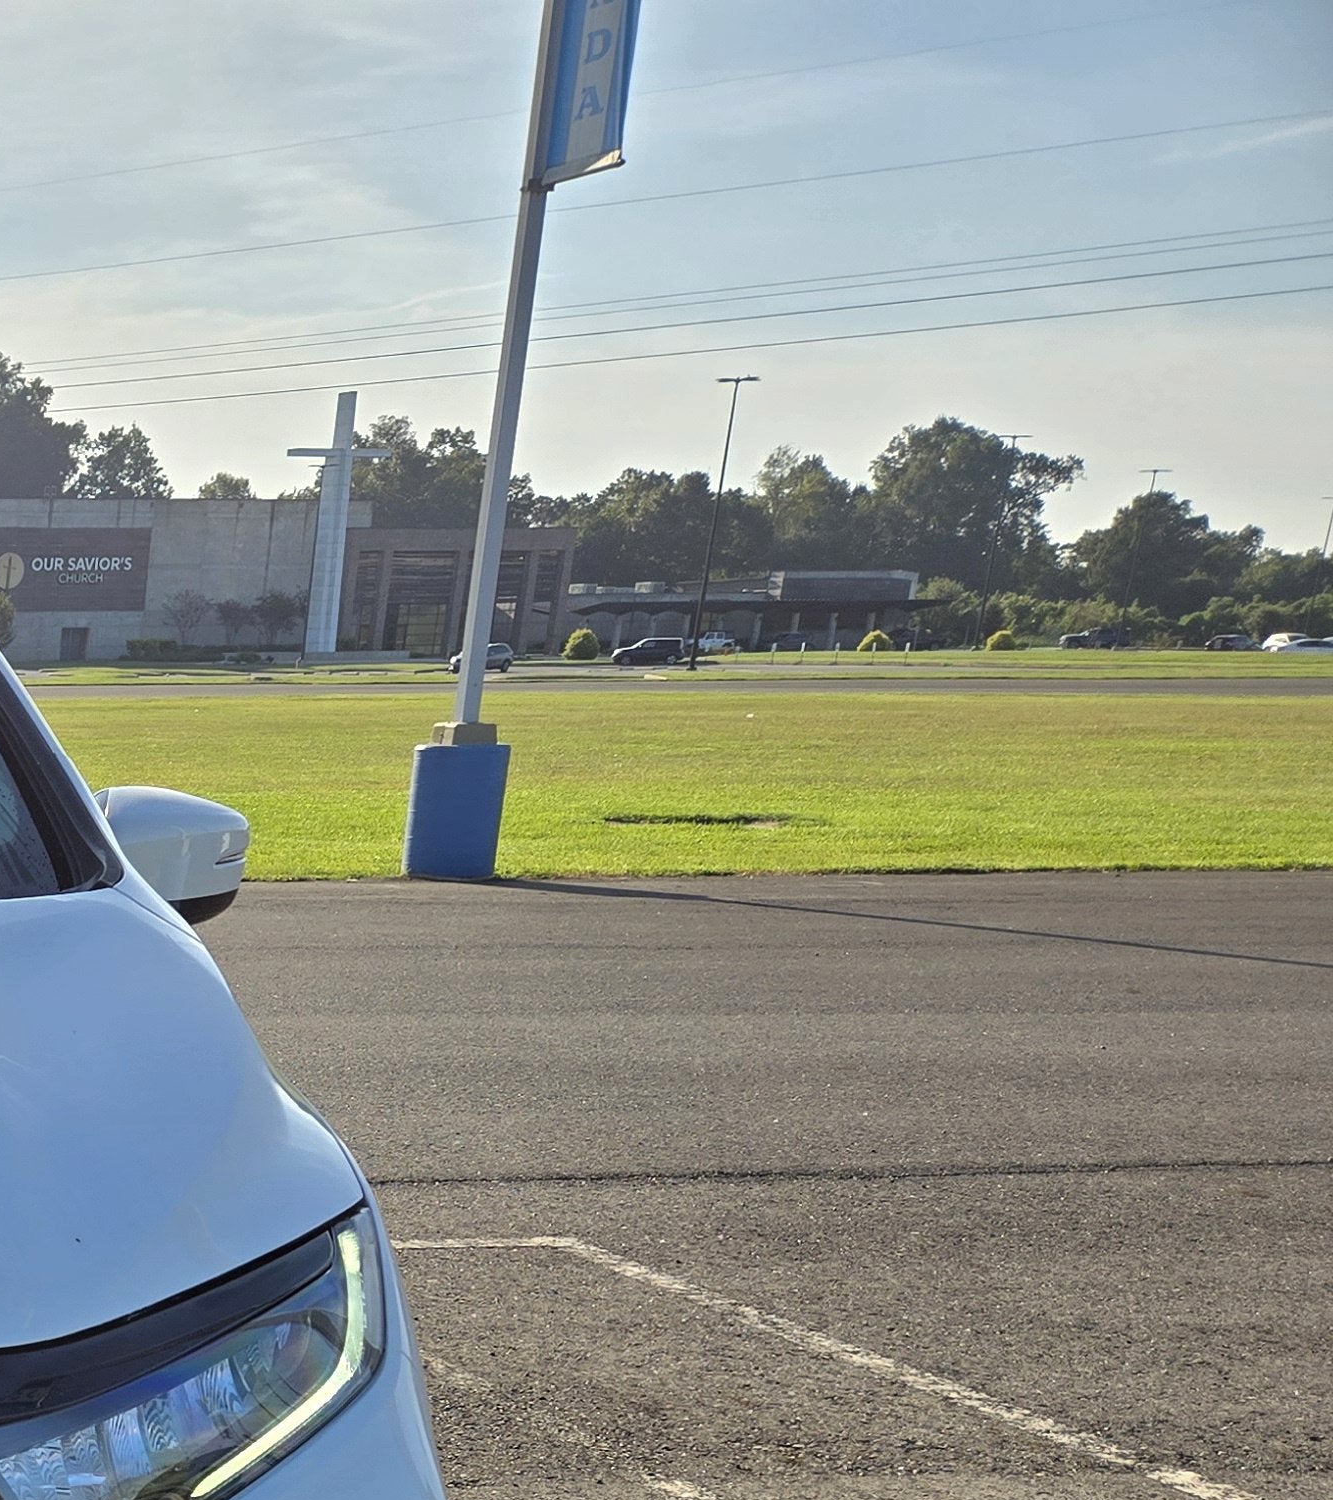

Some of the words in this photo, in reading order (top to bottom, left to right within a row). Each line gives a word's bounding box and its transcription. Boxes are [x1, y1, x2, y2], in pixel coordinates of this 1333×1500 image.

[574, 0, 616, 120] DA
[31, 557, 63, 572] OUR
[67, 557, 133, 572] SAVIOR'S
[58, 572, 103, 584] CHURCH
